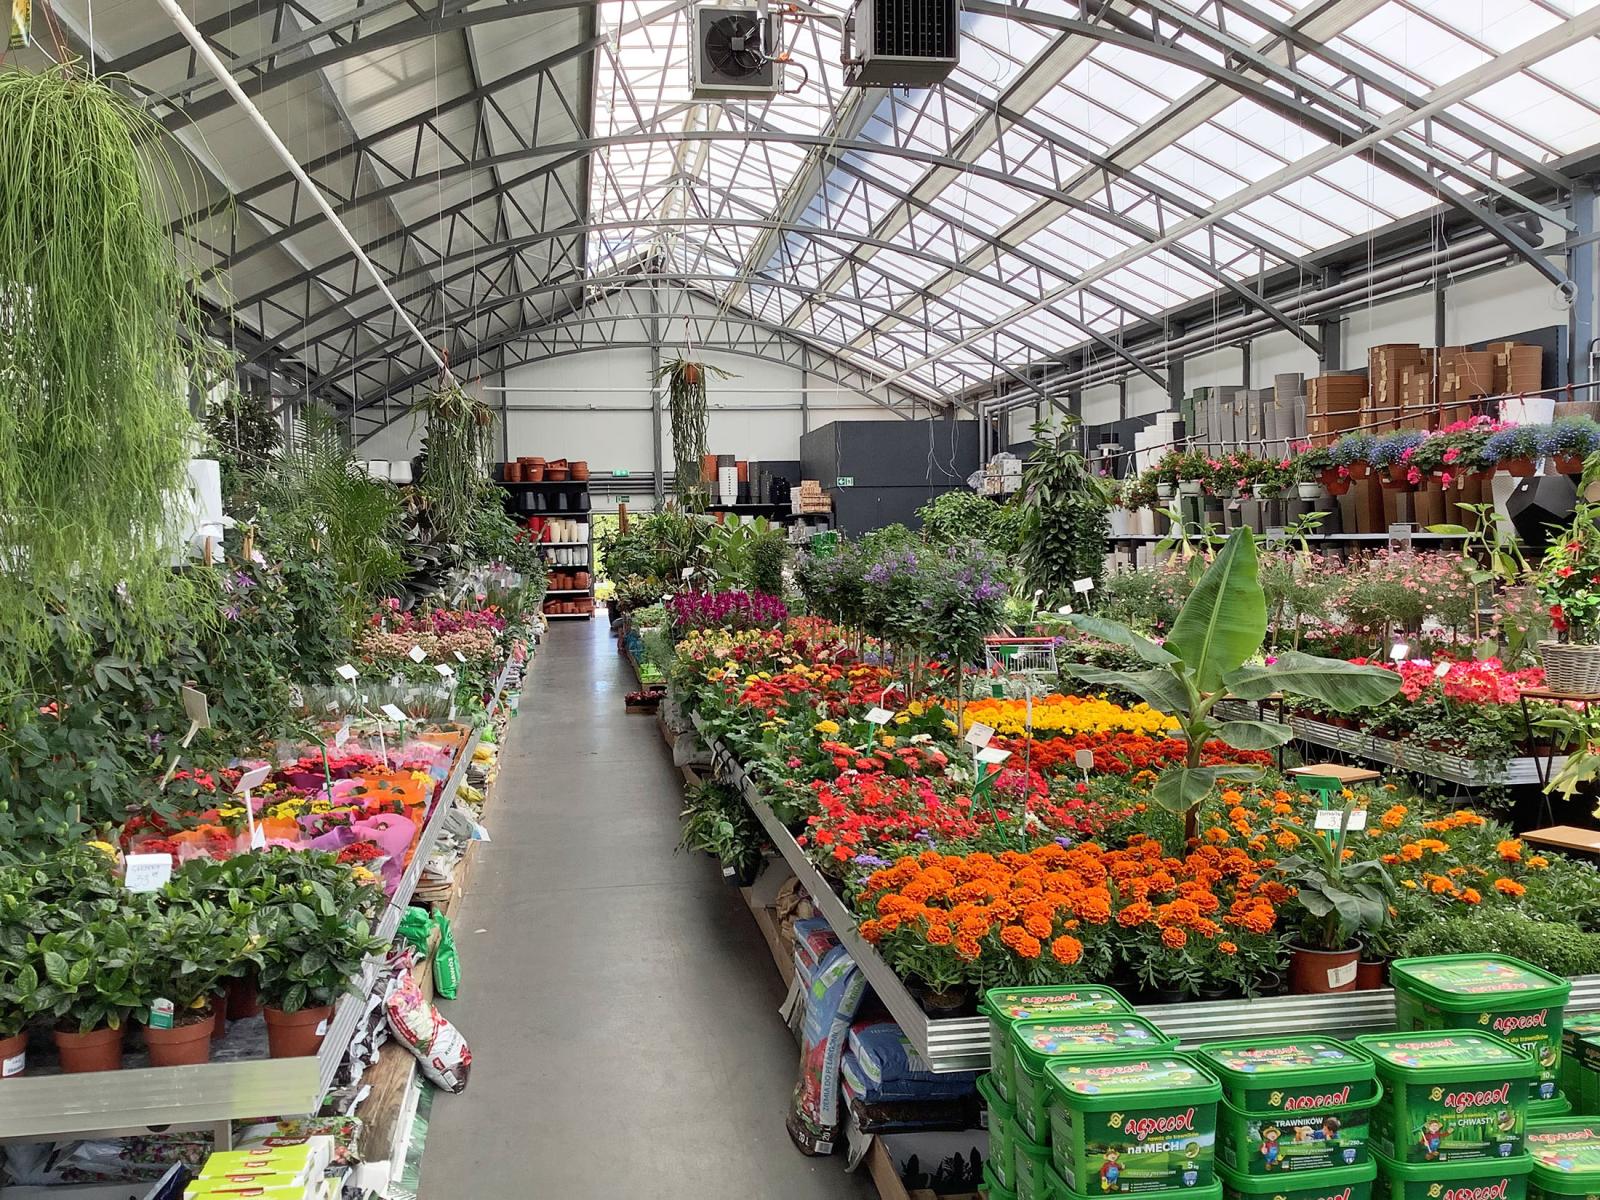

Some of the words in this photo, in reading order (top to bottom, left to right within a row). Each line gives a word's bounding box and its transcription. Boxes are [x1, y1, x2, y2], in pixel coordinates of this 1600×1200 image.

[1493, 1009, 1549, 1035] agrecol
[824, 1075, 831, 1087] DO
[1284, 1086, 1350, 1112] agrecol
[1445, 1083, 1509, 1113] agrecol
[1125, 1107, 1195, 1141] agrecol
[1275, 1117, 1324, 1128] TRAWNIKÓW
[1458, 1117, 1496, 1126] CHWASTY
[1127, 1143, 1142, 1155] na
[1144, 1139, 1180, 1154] MECH
[1187, 1161, 1193, 1169] 5
